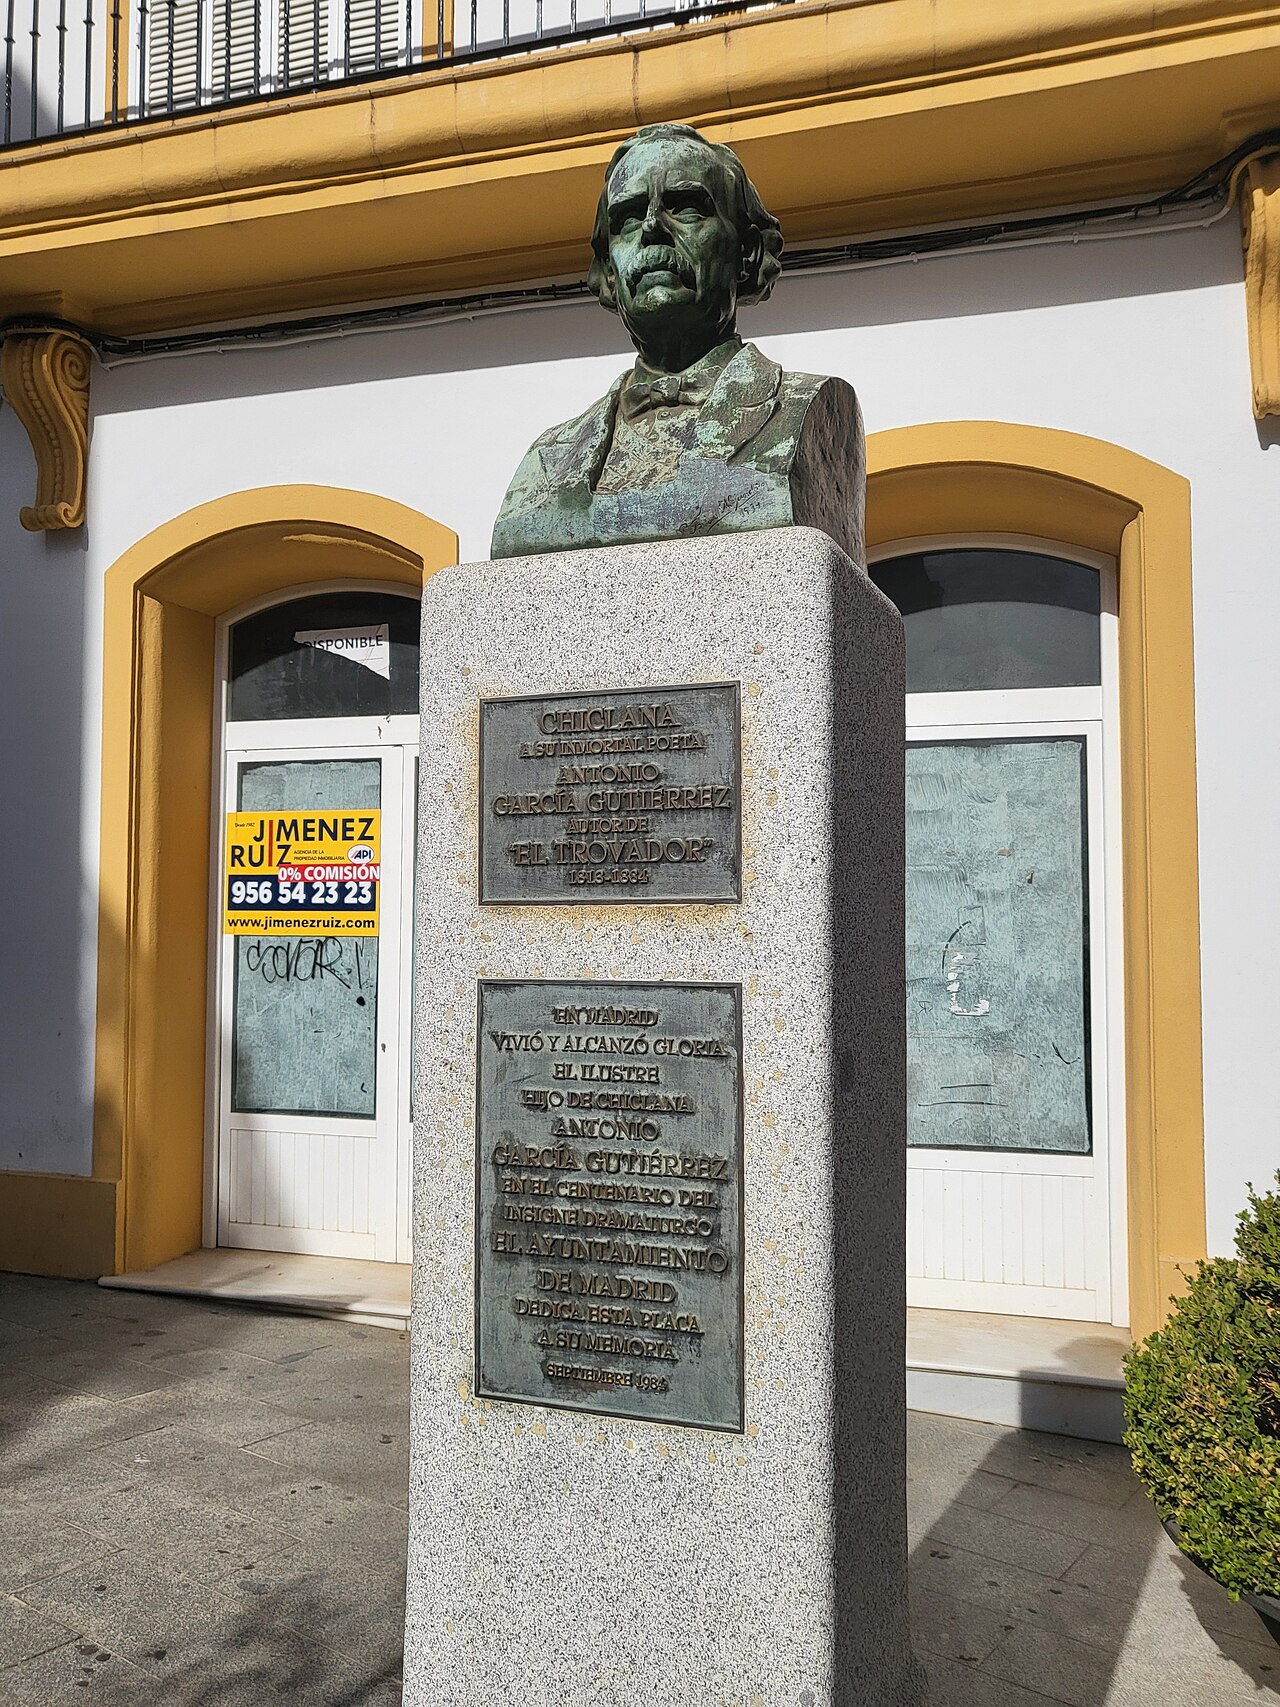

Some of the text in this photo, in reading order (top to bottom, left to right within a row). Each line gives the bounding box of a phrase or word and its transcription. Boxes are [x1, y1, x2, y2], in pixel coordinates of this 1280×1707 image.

[540, 703, 681, 734] CHICLANA
[520, 732, 705, 758] A SU INMORTAL POETA
[557, 763, 660, 785] ANTONIO
[492, 784, 732, 815] GARCÍA GUTIÉRREZ
[253, 818, 375, 842] JIMENEZ
[566, 817, 650, 834] AUTOR DE
[231, 845, 292, 867] RUIZ
[353, 850, 372, 859] API
[278, 863, 380, 881] 0% COMISIÓN
[231, 881, 372, 904] 956 54 23 23
[228, 917, 375, 930] www.jimenezruiz.com
[553, 1006, 659, 1027] EN MADRID
[491, 1030, 728, 1057] VIVIÓ Y ALCANZÓ GLORIA
[552, 1062, 660, 1084] EL ILUSTRE
[521, 1089, 695, 1114] HIJO DE CHICLANA
[553, 1117, 660, 1142] ANTONIO
[491, 1140, 728, 1181] GARCÍA GUTIÉRREZ
[502, 1176, 718, 1208] EN EL CENTENARIO DEL
[504, 1204, 714, 1237] INSIGNE DRAMATURGO
[493, 1232, 729, 1274] EL AYUNTAMIENTO
[538, 1268, 678, 1303] DE MADRID
[515, 1298, 705, 1336] DEDICA ESTA PLACA
[538, 1330, 680, 1361] A SU MEMORIA
[547, 1363, 668, 1392] SEPTIEMBRE 1984
